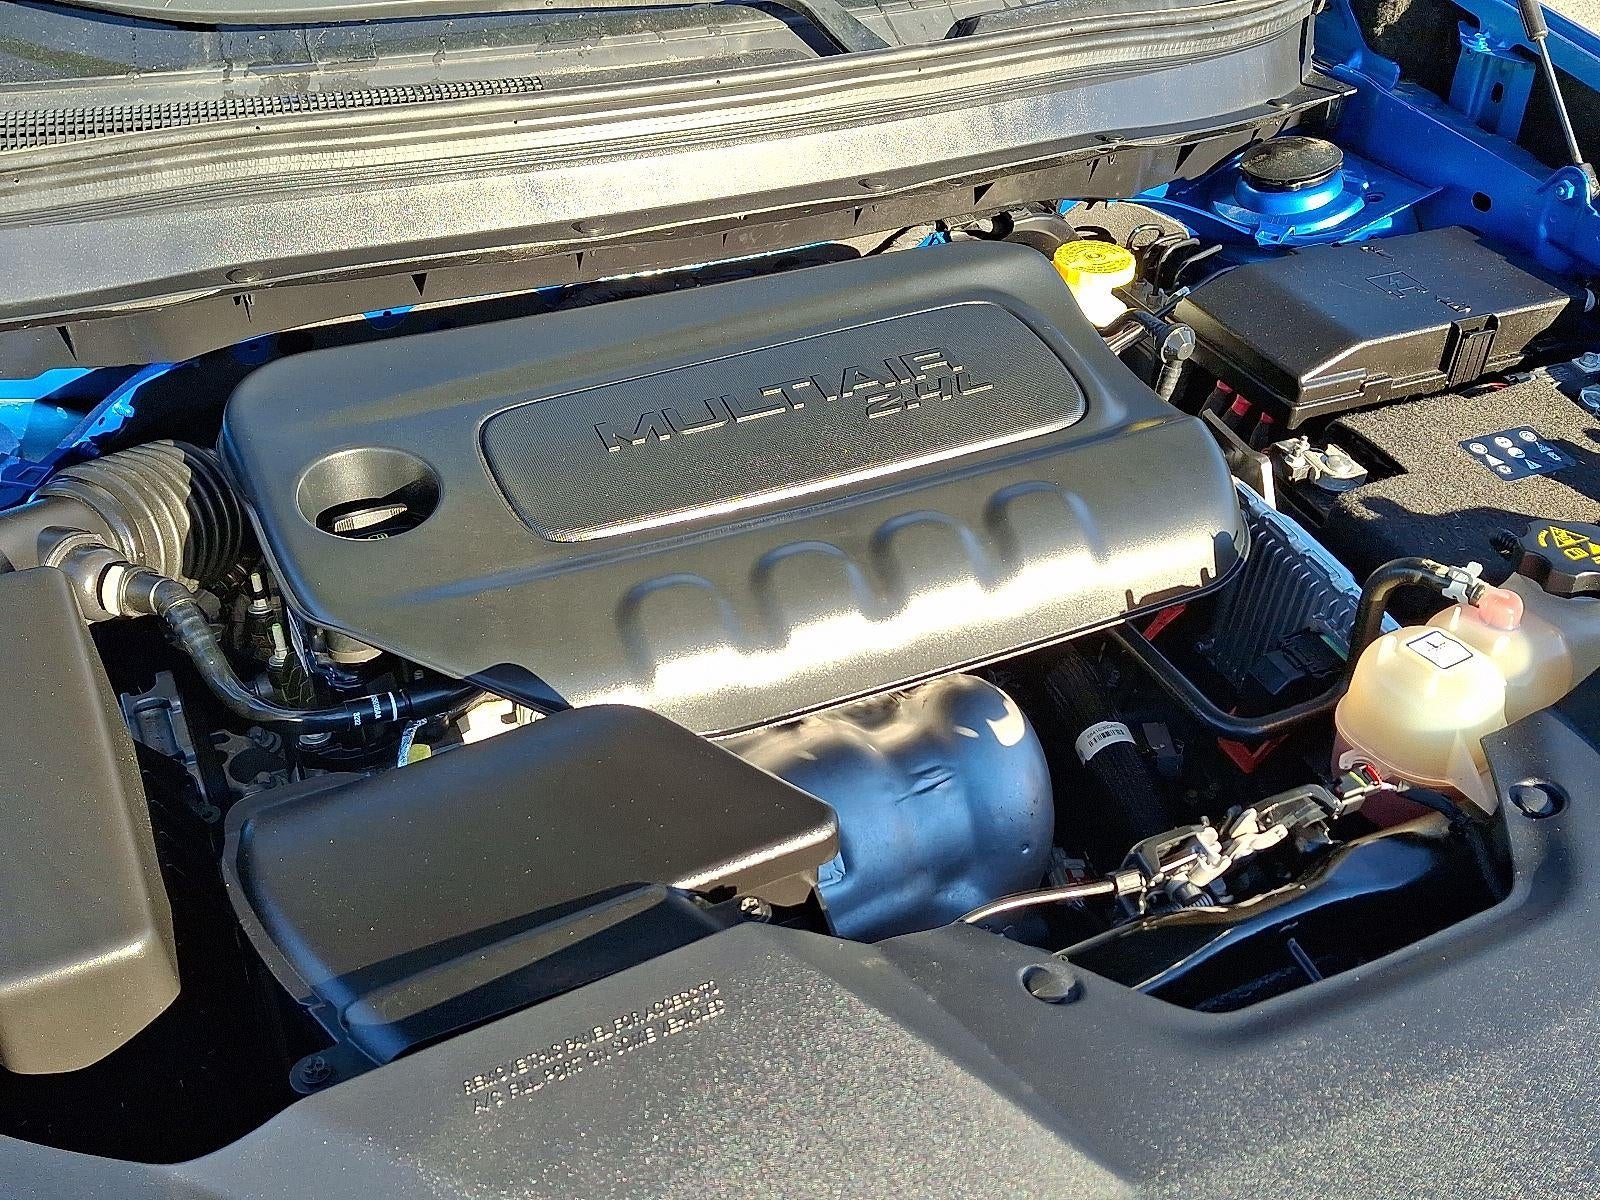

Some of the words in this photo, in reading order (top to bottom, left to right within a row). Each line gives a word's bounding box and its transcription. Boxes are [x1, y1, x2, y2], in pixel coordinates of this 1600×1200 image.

[594, 347, 964, 452] MULTIAIR
[865, 371, 994, 420] 2.4L
[461, 1056, 531, 1096] REMOVE
[525, 1042, 564, 1070] THIS
[562, 1022, 613, 1054] PANEL
[506, 1072, 545, 1099] FILL
[542, 1055, 586, 1085] PORT
